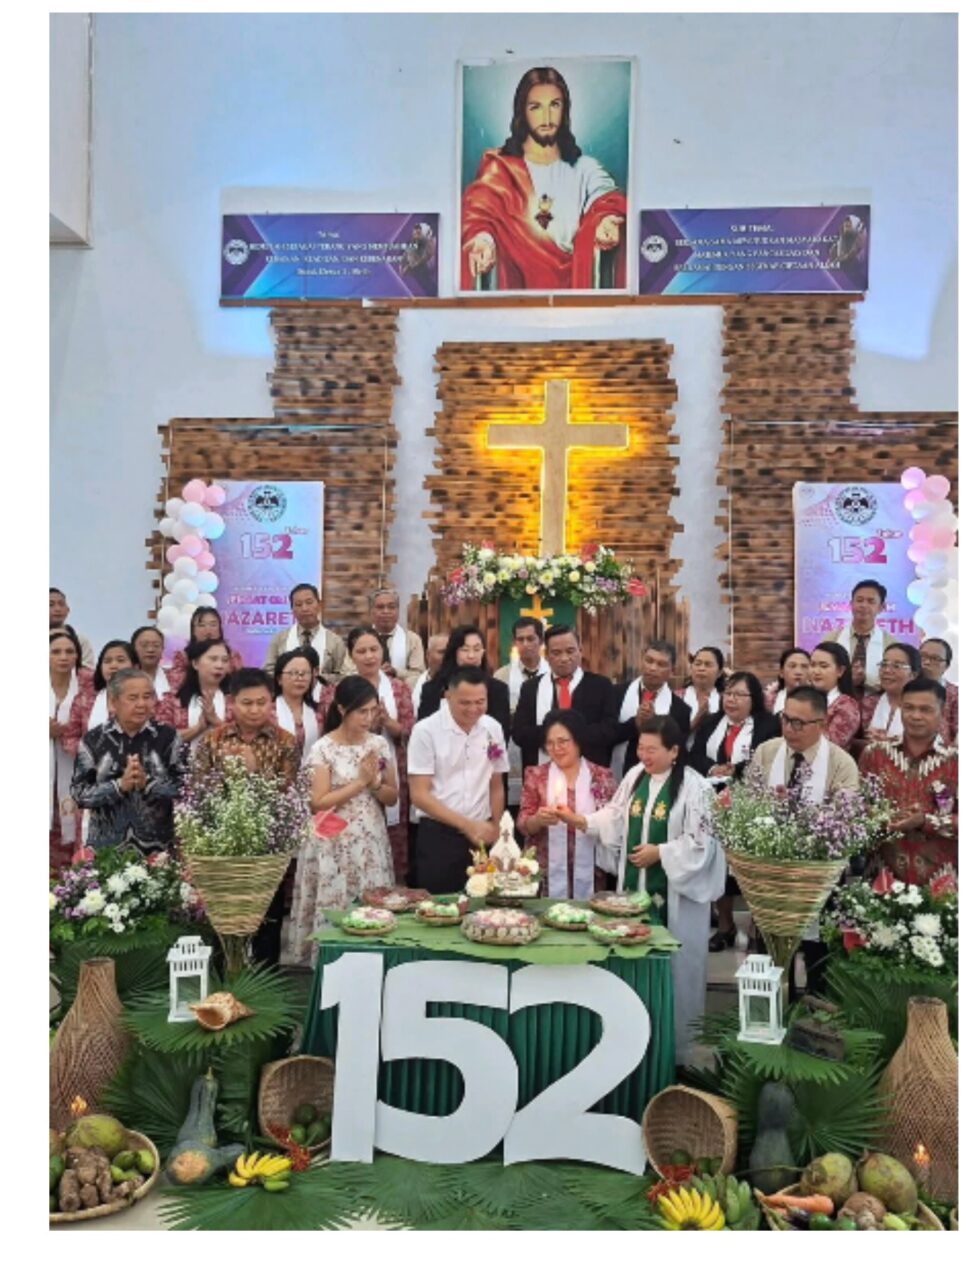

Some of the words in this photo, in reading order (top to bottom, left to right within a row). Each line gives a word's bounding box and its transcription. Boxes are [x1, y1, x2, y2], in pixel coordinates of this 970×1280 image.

[240, 532, 294, 560] 152
[828, 536, 888, 564] 152
[320, 952, 652, 1176] 152
